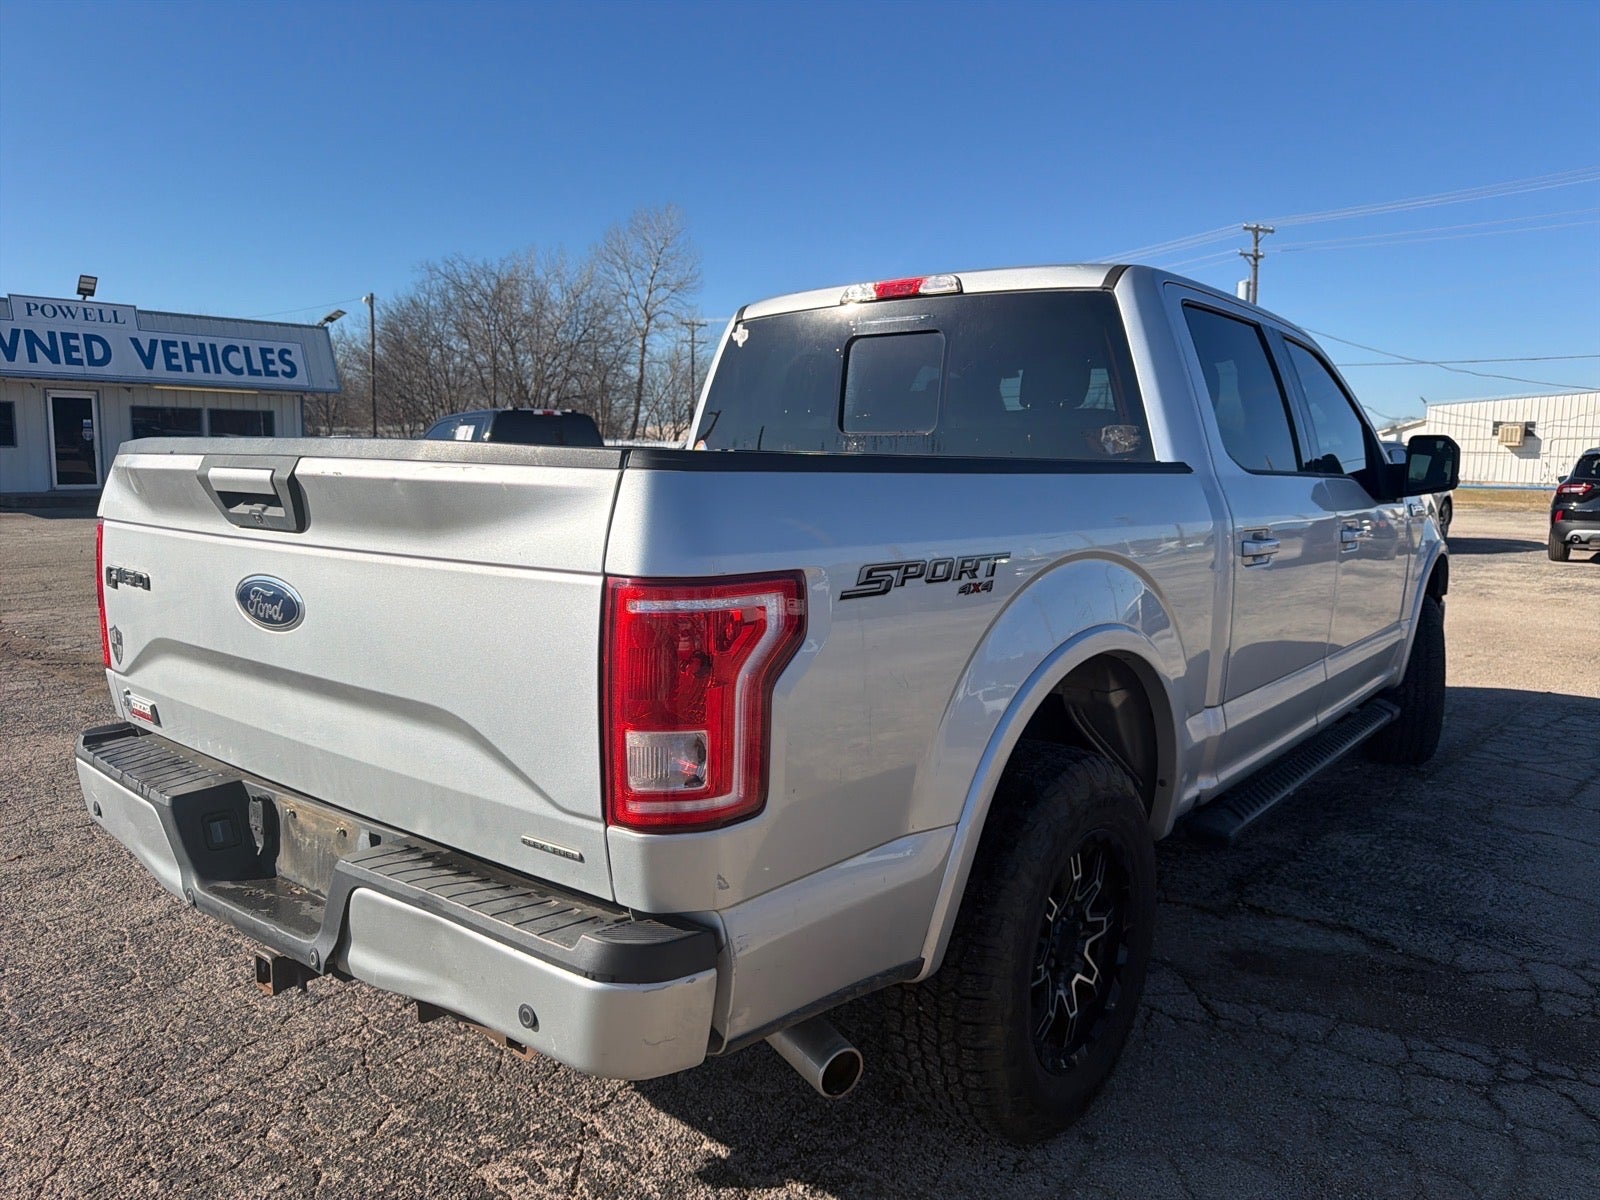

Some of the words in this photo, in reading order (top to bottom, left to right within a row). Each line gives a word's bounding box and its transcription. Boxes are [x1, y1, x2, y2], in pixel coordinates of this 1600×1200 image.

[25, 302, 126, 325] POWELL
[129, 337, 298, 379] VEHICLES
[839, 552, 1011, 601] SPORT
[248, 586, 284, 622] Ford
